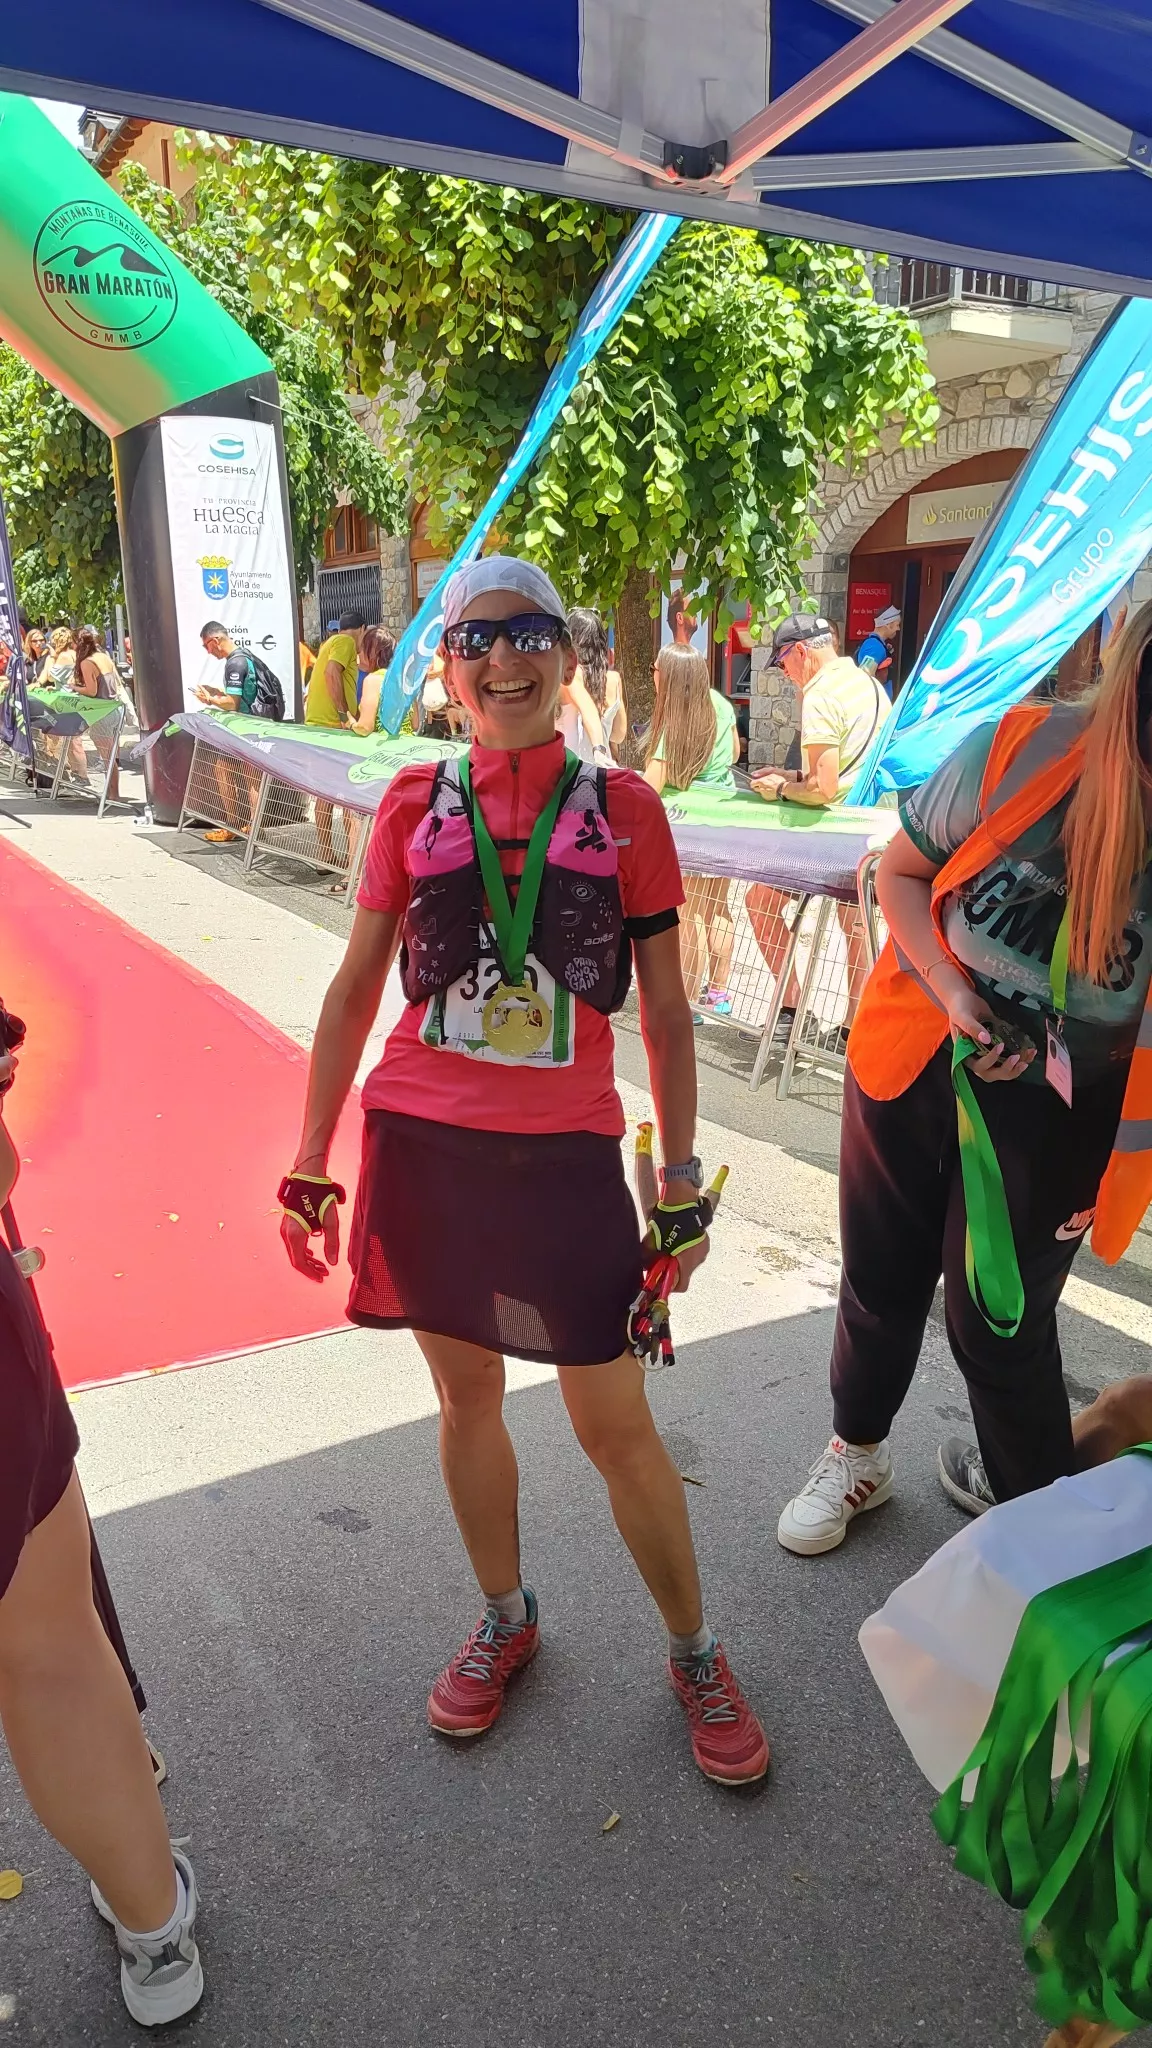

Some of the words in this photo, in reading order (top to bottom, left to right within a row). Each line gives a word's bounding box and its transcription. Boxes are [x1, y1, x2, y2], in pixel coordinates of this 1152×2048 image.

[48, 205, 94, 236] MONTAÑAS
[94, 207, 107, 220] DE
[107, 211, 150, 251] BENASQUE
[43, 269, 91, 295] GRAN
[95, 271, 174, 300] MARATÓN
[197, 464, 257, 476] COSEHISA
[939, 500, 995, 524] Santand
[230, 570, 272, 579] Ayuntamiento
[1051, 526, 1115, 607] Grupo
[230, 579, 250, 589] Villa
[230, 588, 273, 600] Benasque
[909, 814, 924, 832] 2025
[300, 1193, 317, 1219] LEKI
[663, 1223, 682, 1248] LEKI
